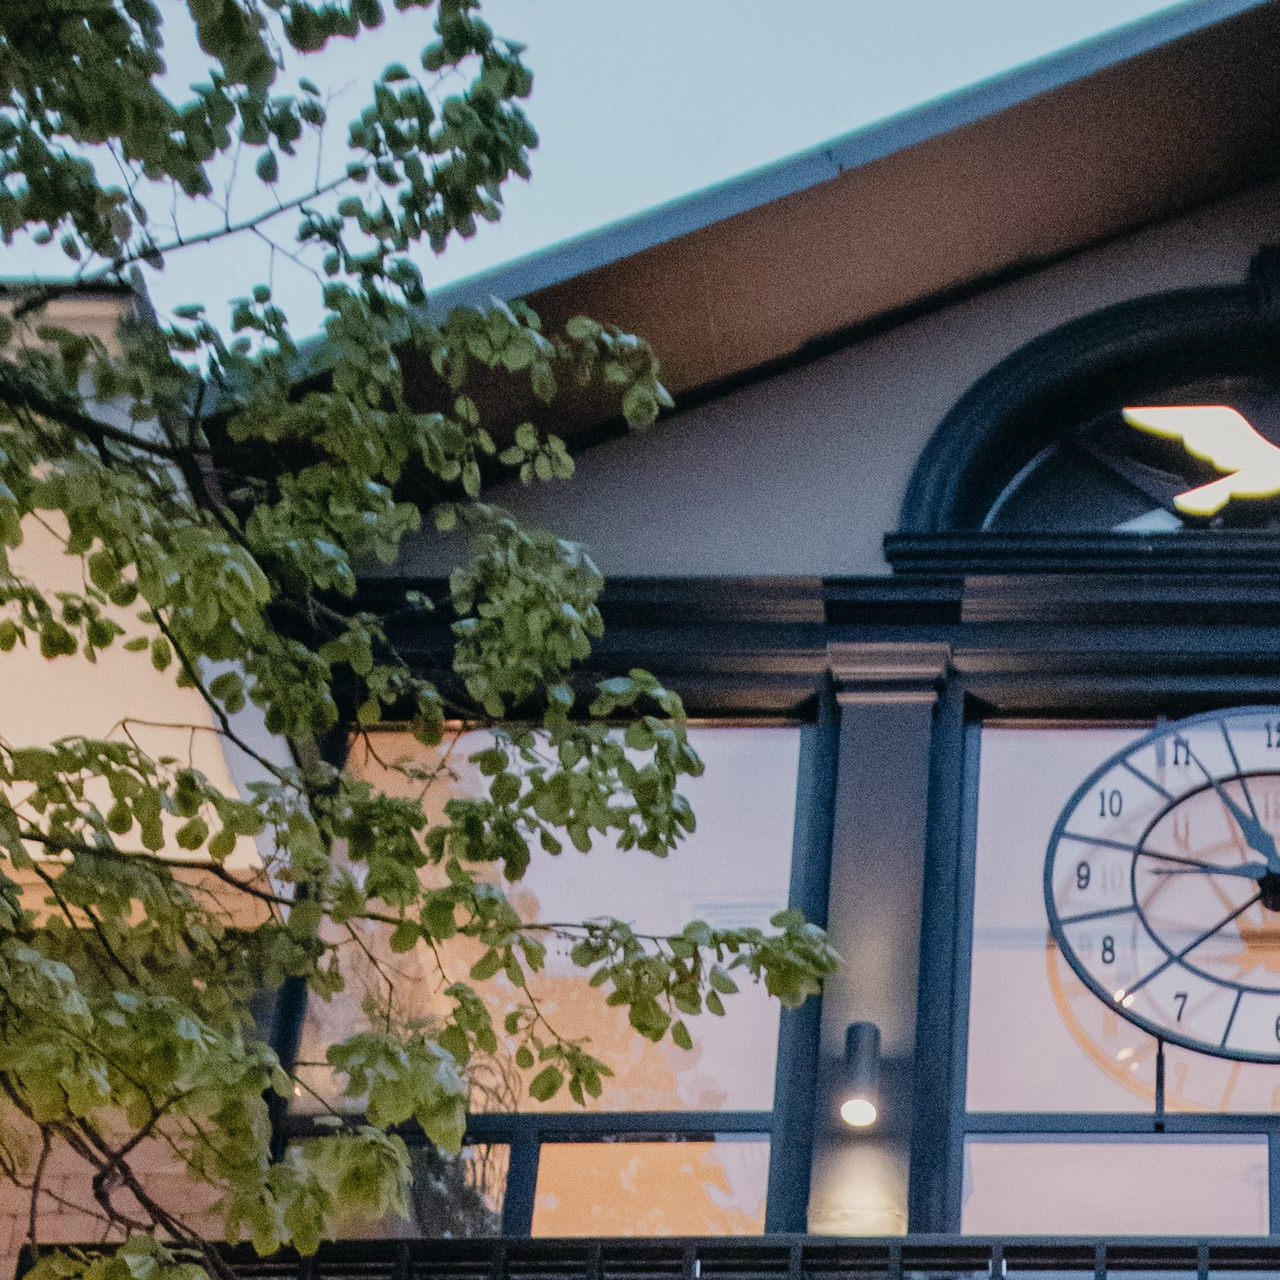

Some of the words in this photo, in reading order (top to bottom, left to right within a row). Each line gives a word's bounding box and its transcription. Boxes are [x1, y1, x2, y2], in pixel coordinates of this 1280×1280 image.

[1098, 789, 1122, 817] 10
[1076, 862, 1091, 890] 9
[1102, 936, 1116, 964] 8
[1173, 993, 1188, 1021] 7
